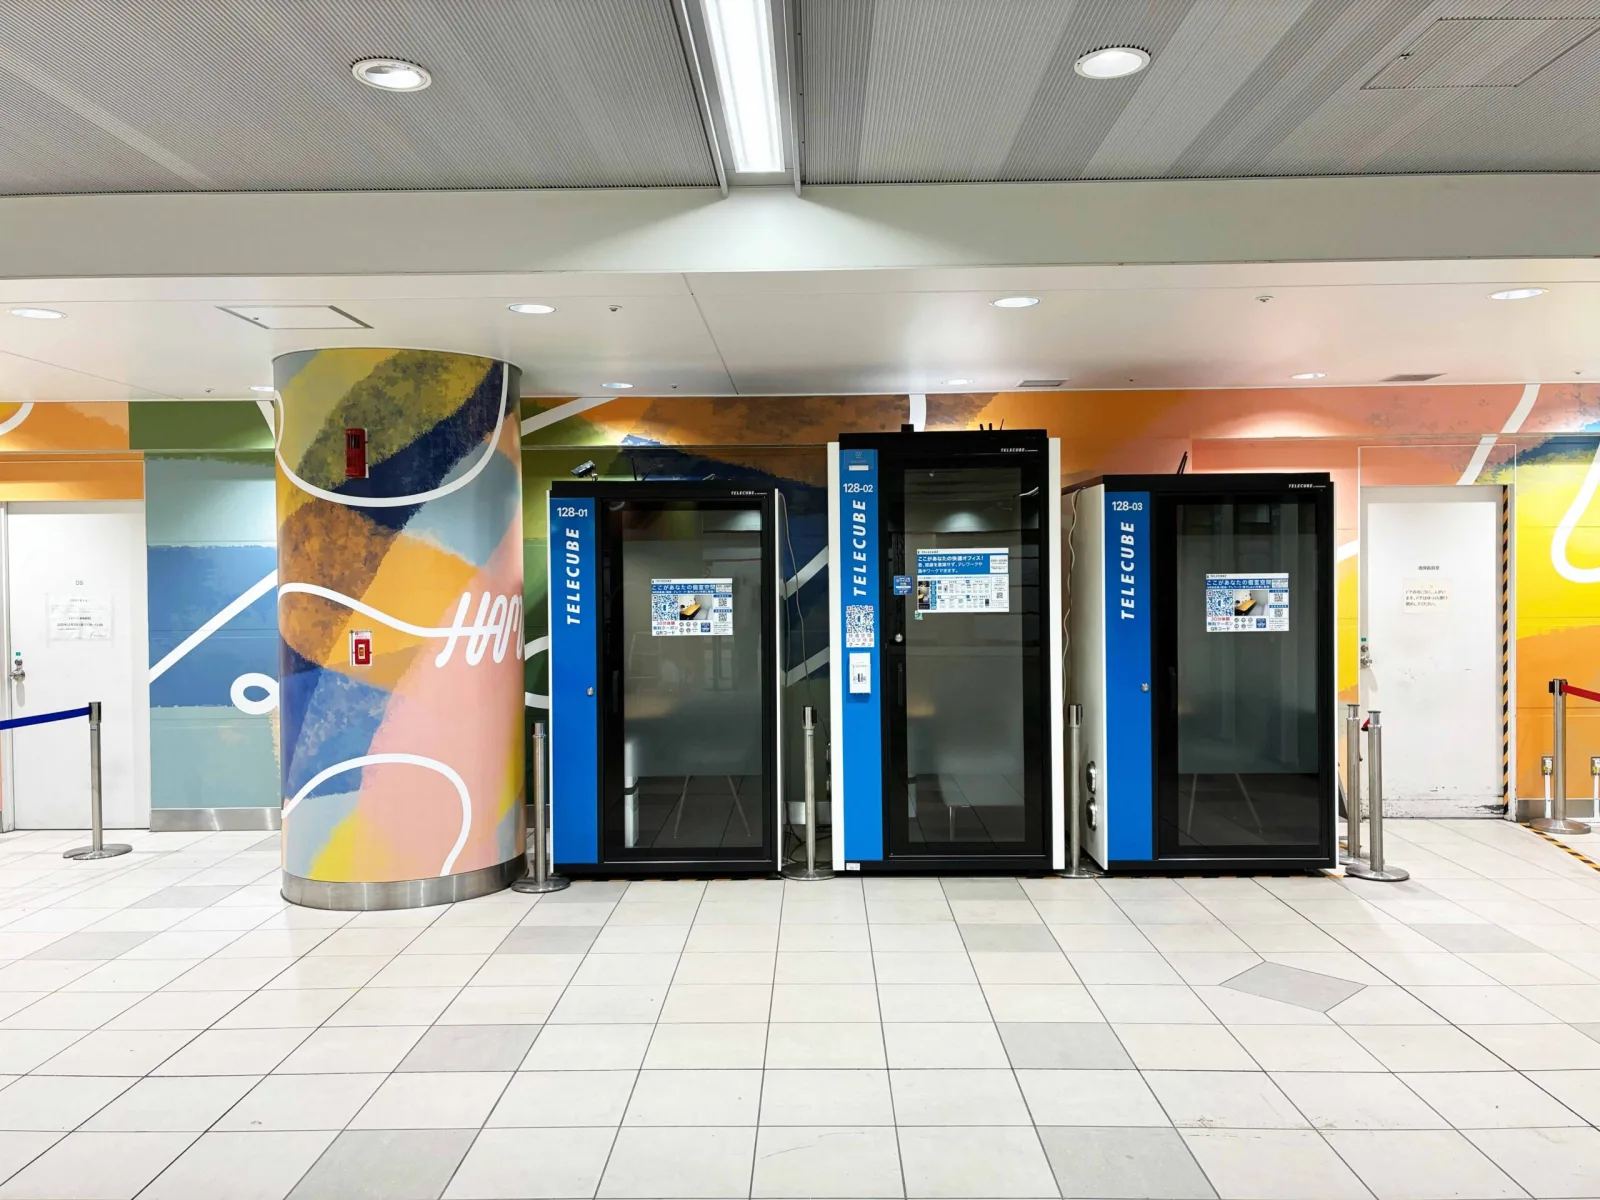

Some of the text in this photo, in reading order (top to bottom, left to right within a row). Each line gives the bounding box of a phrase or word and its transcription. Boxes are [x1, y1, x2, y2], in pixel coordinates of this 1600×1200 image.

[556, 507, 588, 518] 128-01
[843, 483, 874, 493] 128-02
[1112, 501, 1143, 511] 128-03
[853, 499, 867, 597] TELECUBE
[1120, 521, 1135, 620] TELECUBE
[566, 528, 580, 625] TELECUBE
